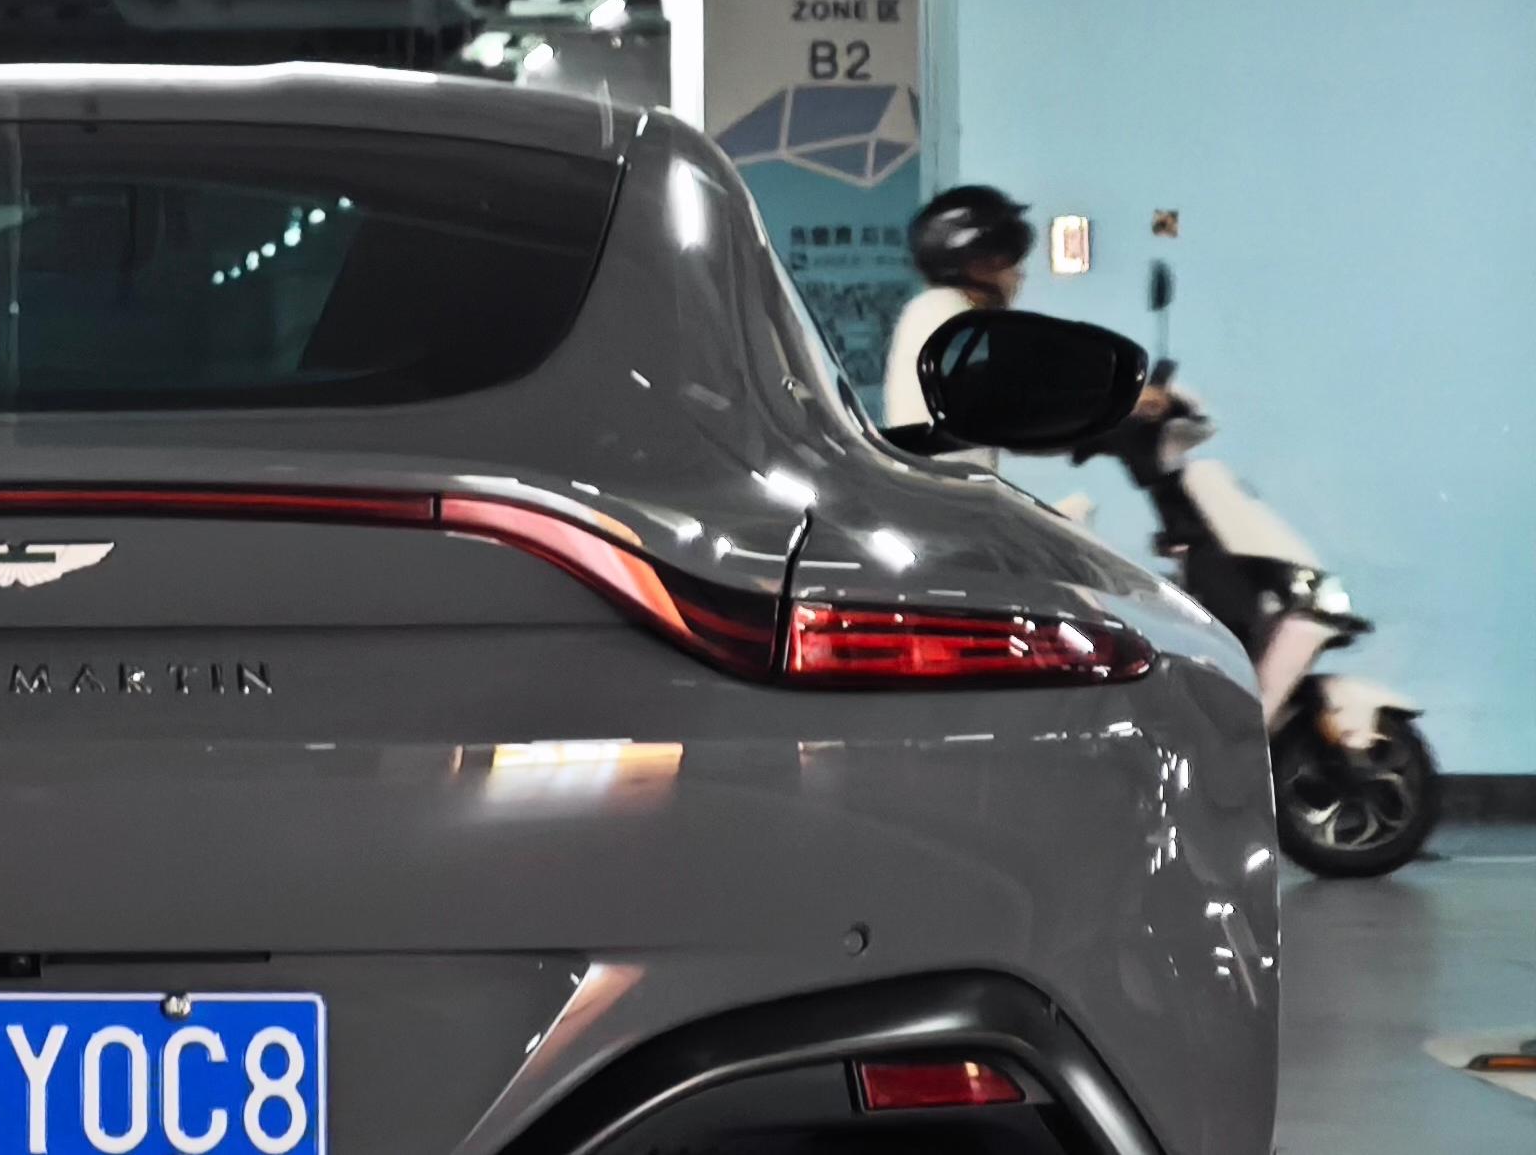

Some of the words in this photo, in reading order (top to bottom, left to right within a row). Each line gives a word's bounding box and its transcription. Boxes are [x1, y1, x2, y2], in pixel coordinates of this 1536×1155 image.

[791, 0, 868, 22] ZONE
[809, 40, 871, 79] B2
[9, 662, 273, 695] MARTIN
